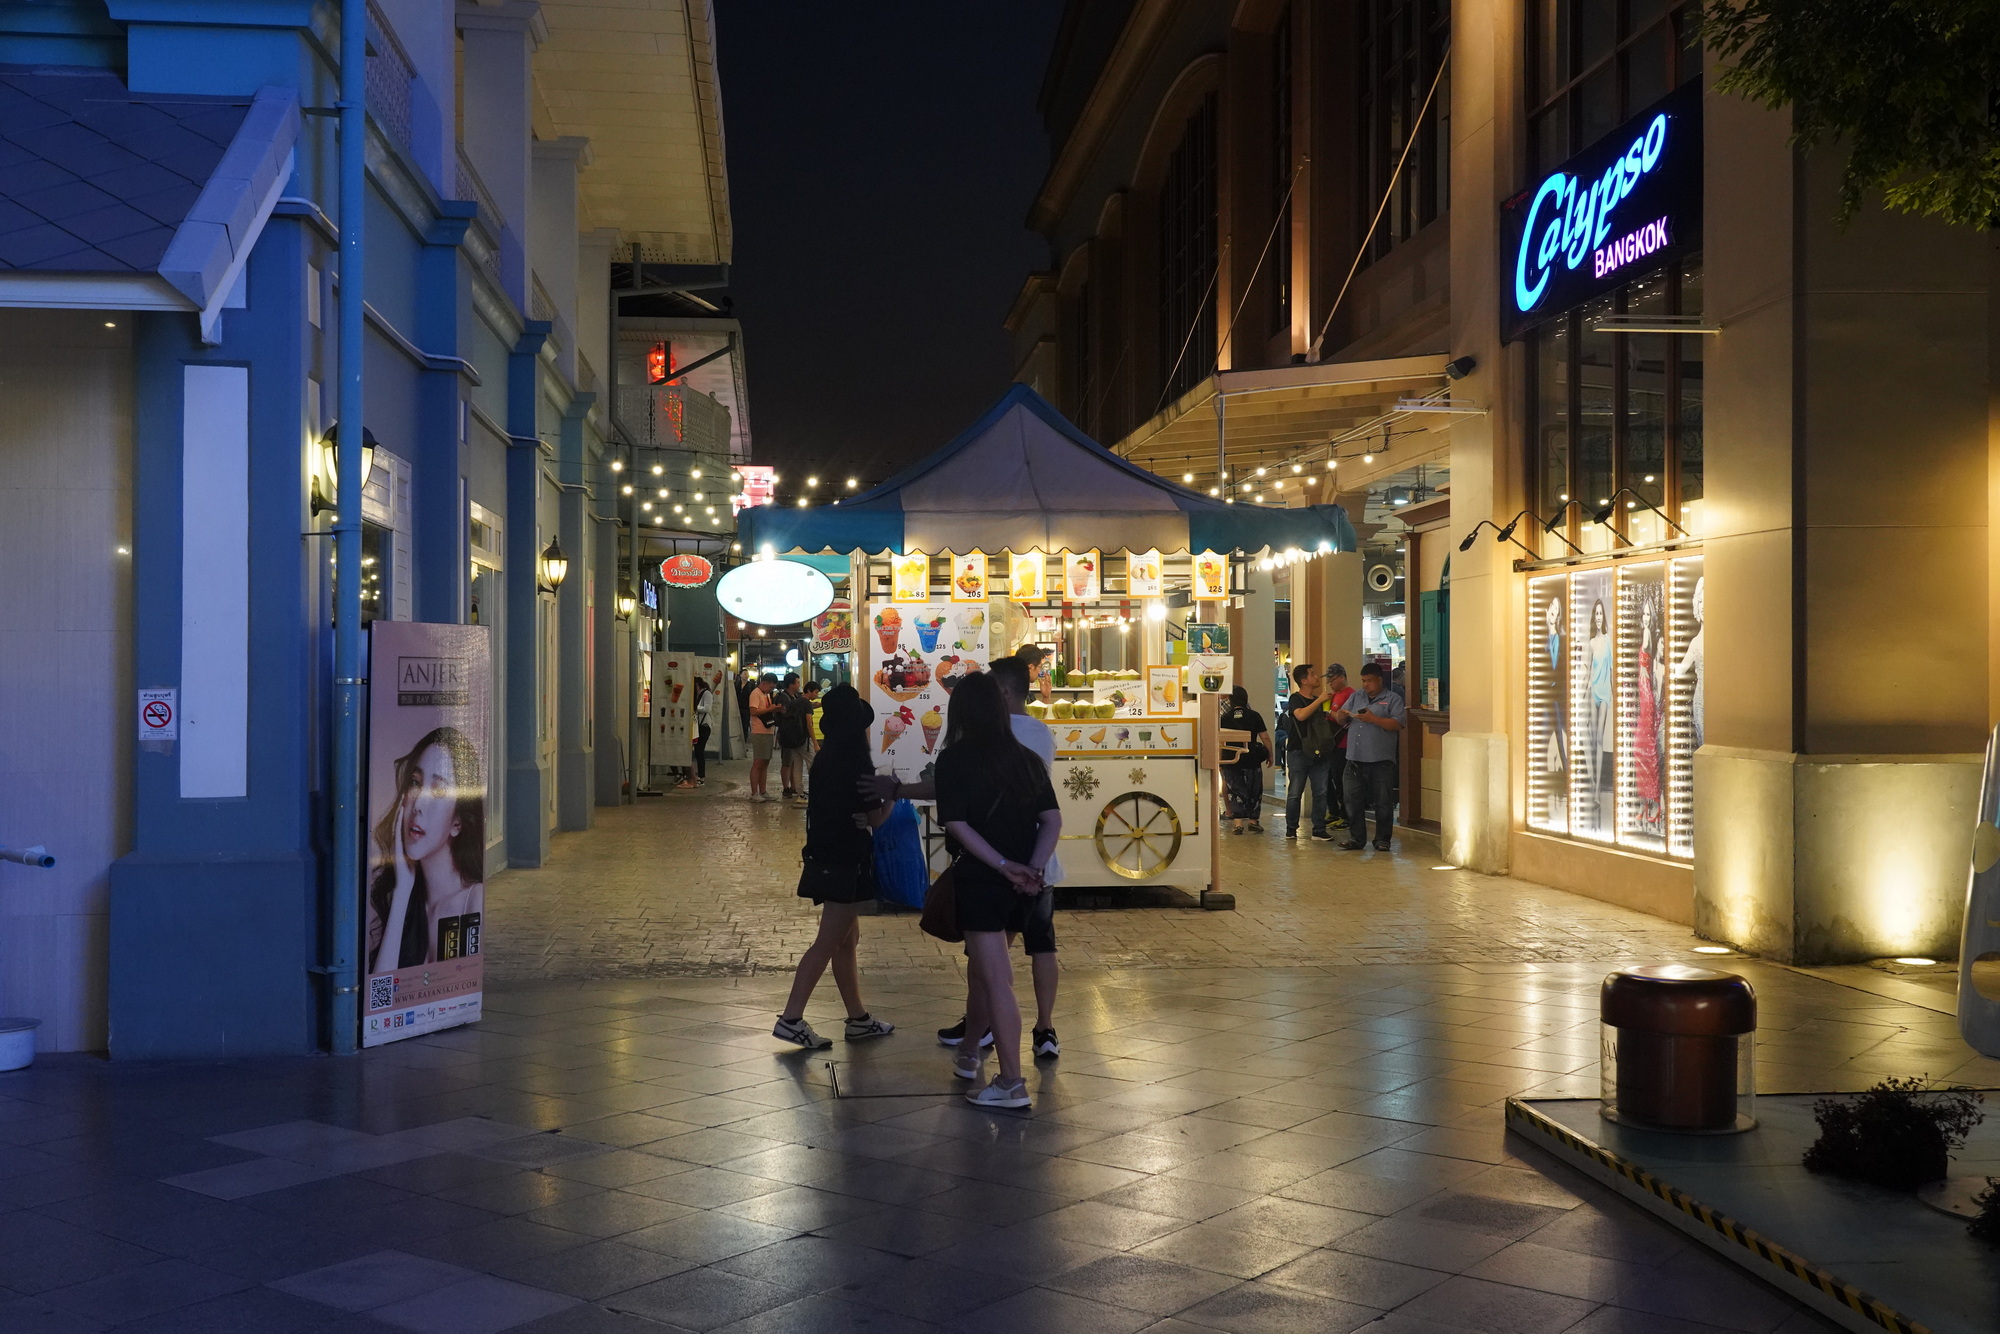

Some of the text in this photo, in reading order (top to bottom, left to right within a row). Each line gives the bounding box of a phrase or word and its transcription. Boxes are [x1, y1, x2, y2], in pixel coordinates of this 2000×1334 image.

[1515, 113, 1666, 312] Calypso
[1595, 216, 1668, 278] BANGKOK
[1208, 585, 1223, 593] 125
[967, 590, 981, 598] 105
[813, 639, 837, 650] JUST
[1128, 708, 1142, 716] 125
[887, 748, 896, 756] 75
